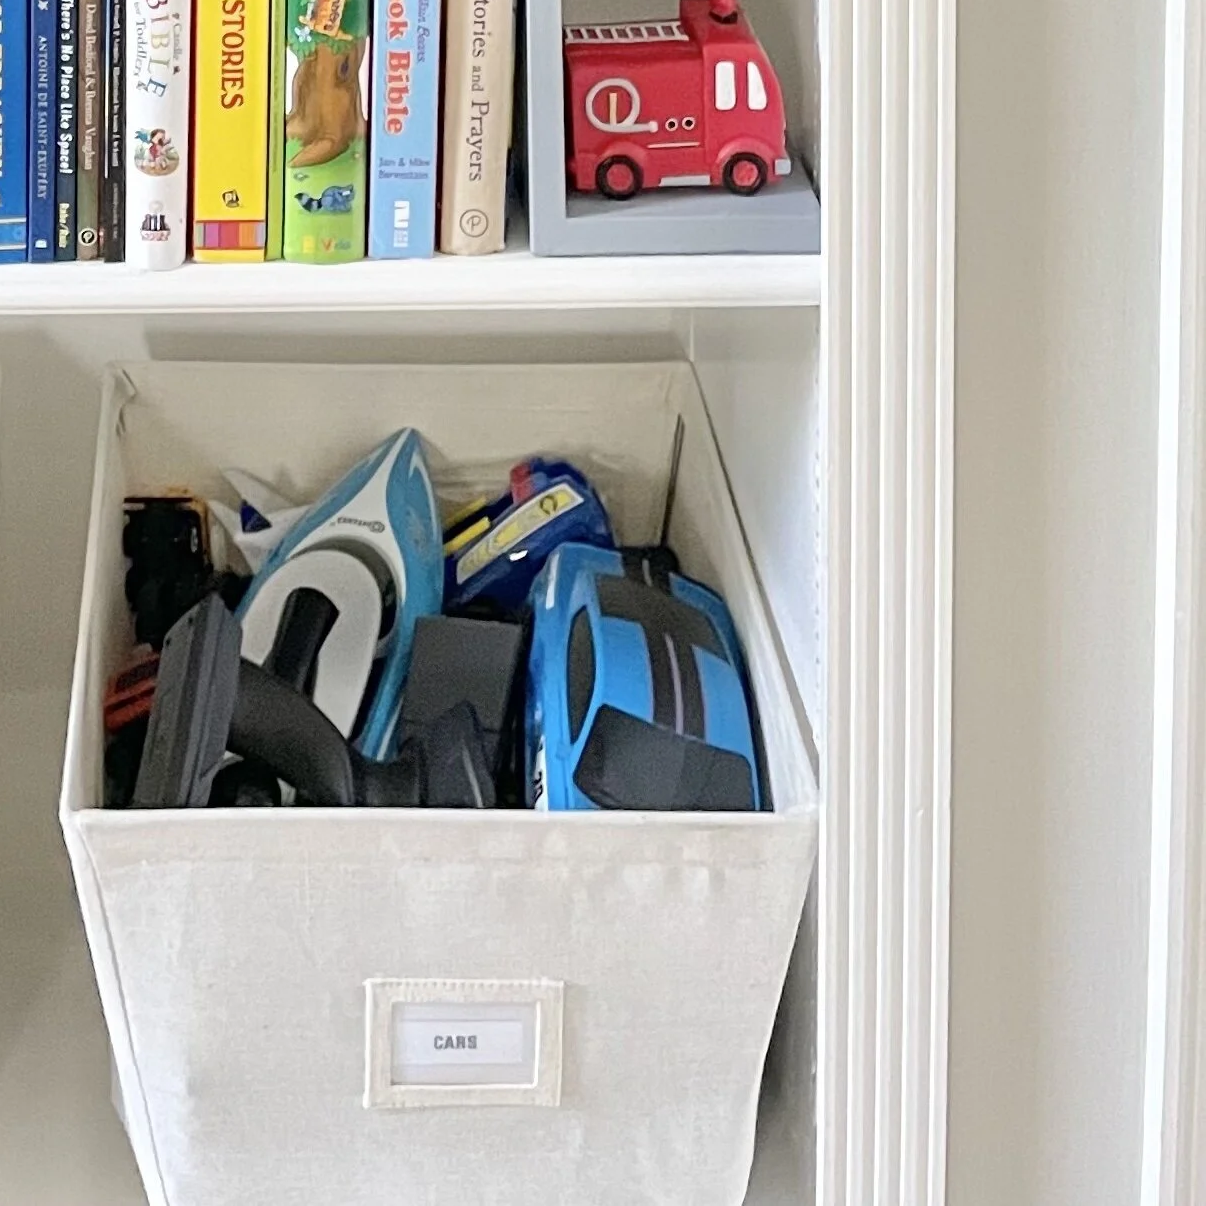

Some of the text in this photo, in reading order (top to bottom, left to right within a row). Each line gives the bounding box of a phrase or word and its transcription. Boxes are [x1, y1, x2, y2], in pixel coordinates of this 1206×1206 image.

[37, 35, 49, 89] ANTOINE
[60, 45, 73, 62] No
[133, 18, 148, 76] Toddlers
[220, 0, 246, 109] STORIES
[60, 67, 73, 100] Place
[385, 50, 412, 135] Bible
[472, 66, 484, 91] and
[38, 93, 49, 106] DE
[60, 104, 72, 128] Like
[57, 132, 72, 174] Space!
[467, 99, 490, 181] Prayers
[433, 1034, 478, 1051] CARS
